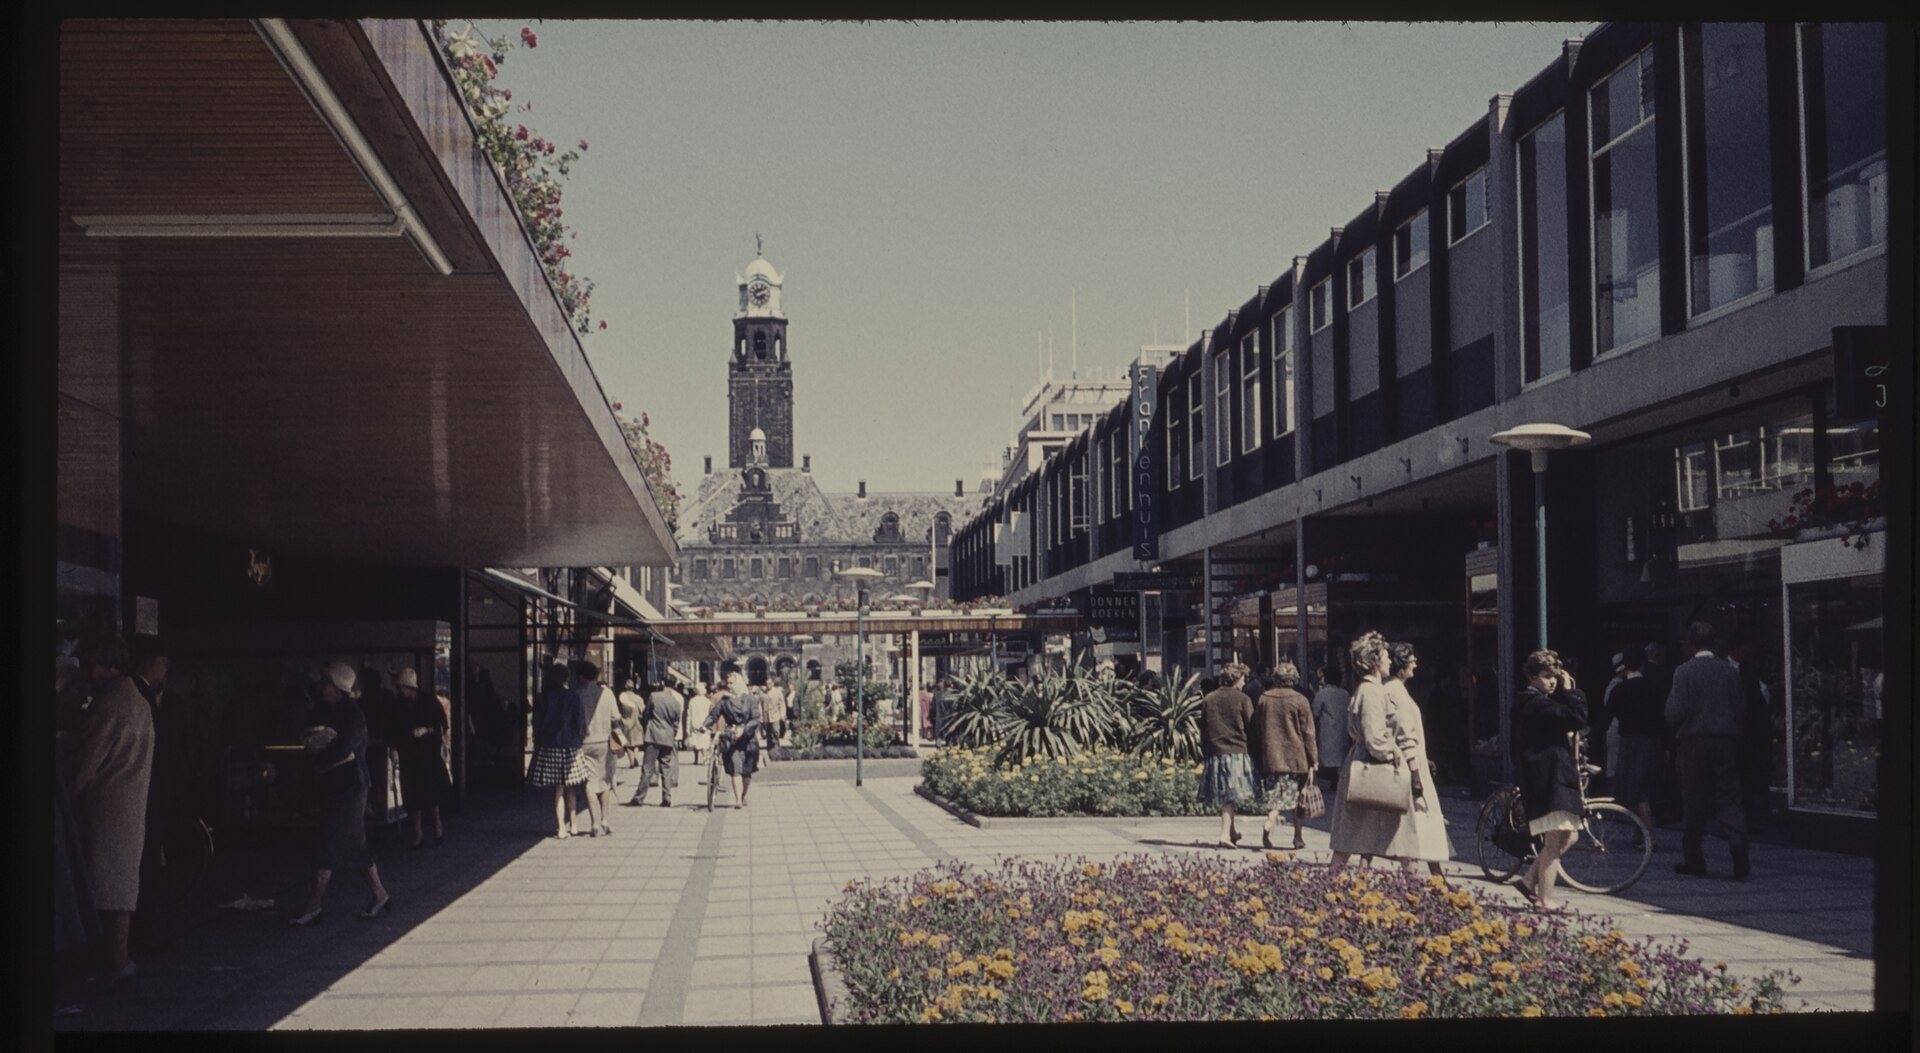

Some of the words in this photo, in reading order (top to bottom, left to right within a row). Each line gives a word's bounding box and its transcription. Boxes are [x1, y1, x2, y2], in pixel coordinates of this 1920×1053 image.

[1138, 368, 1151, 557] Frankenhuis
[1090, 596, 1137, 606] DONNER
[1091, 608, 1136, 619] BOEKEN
